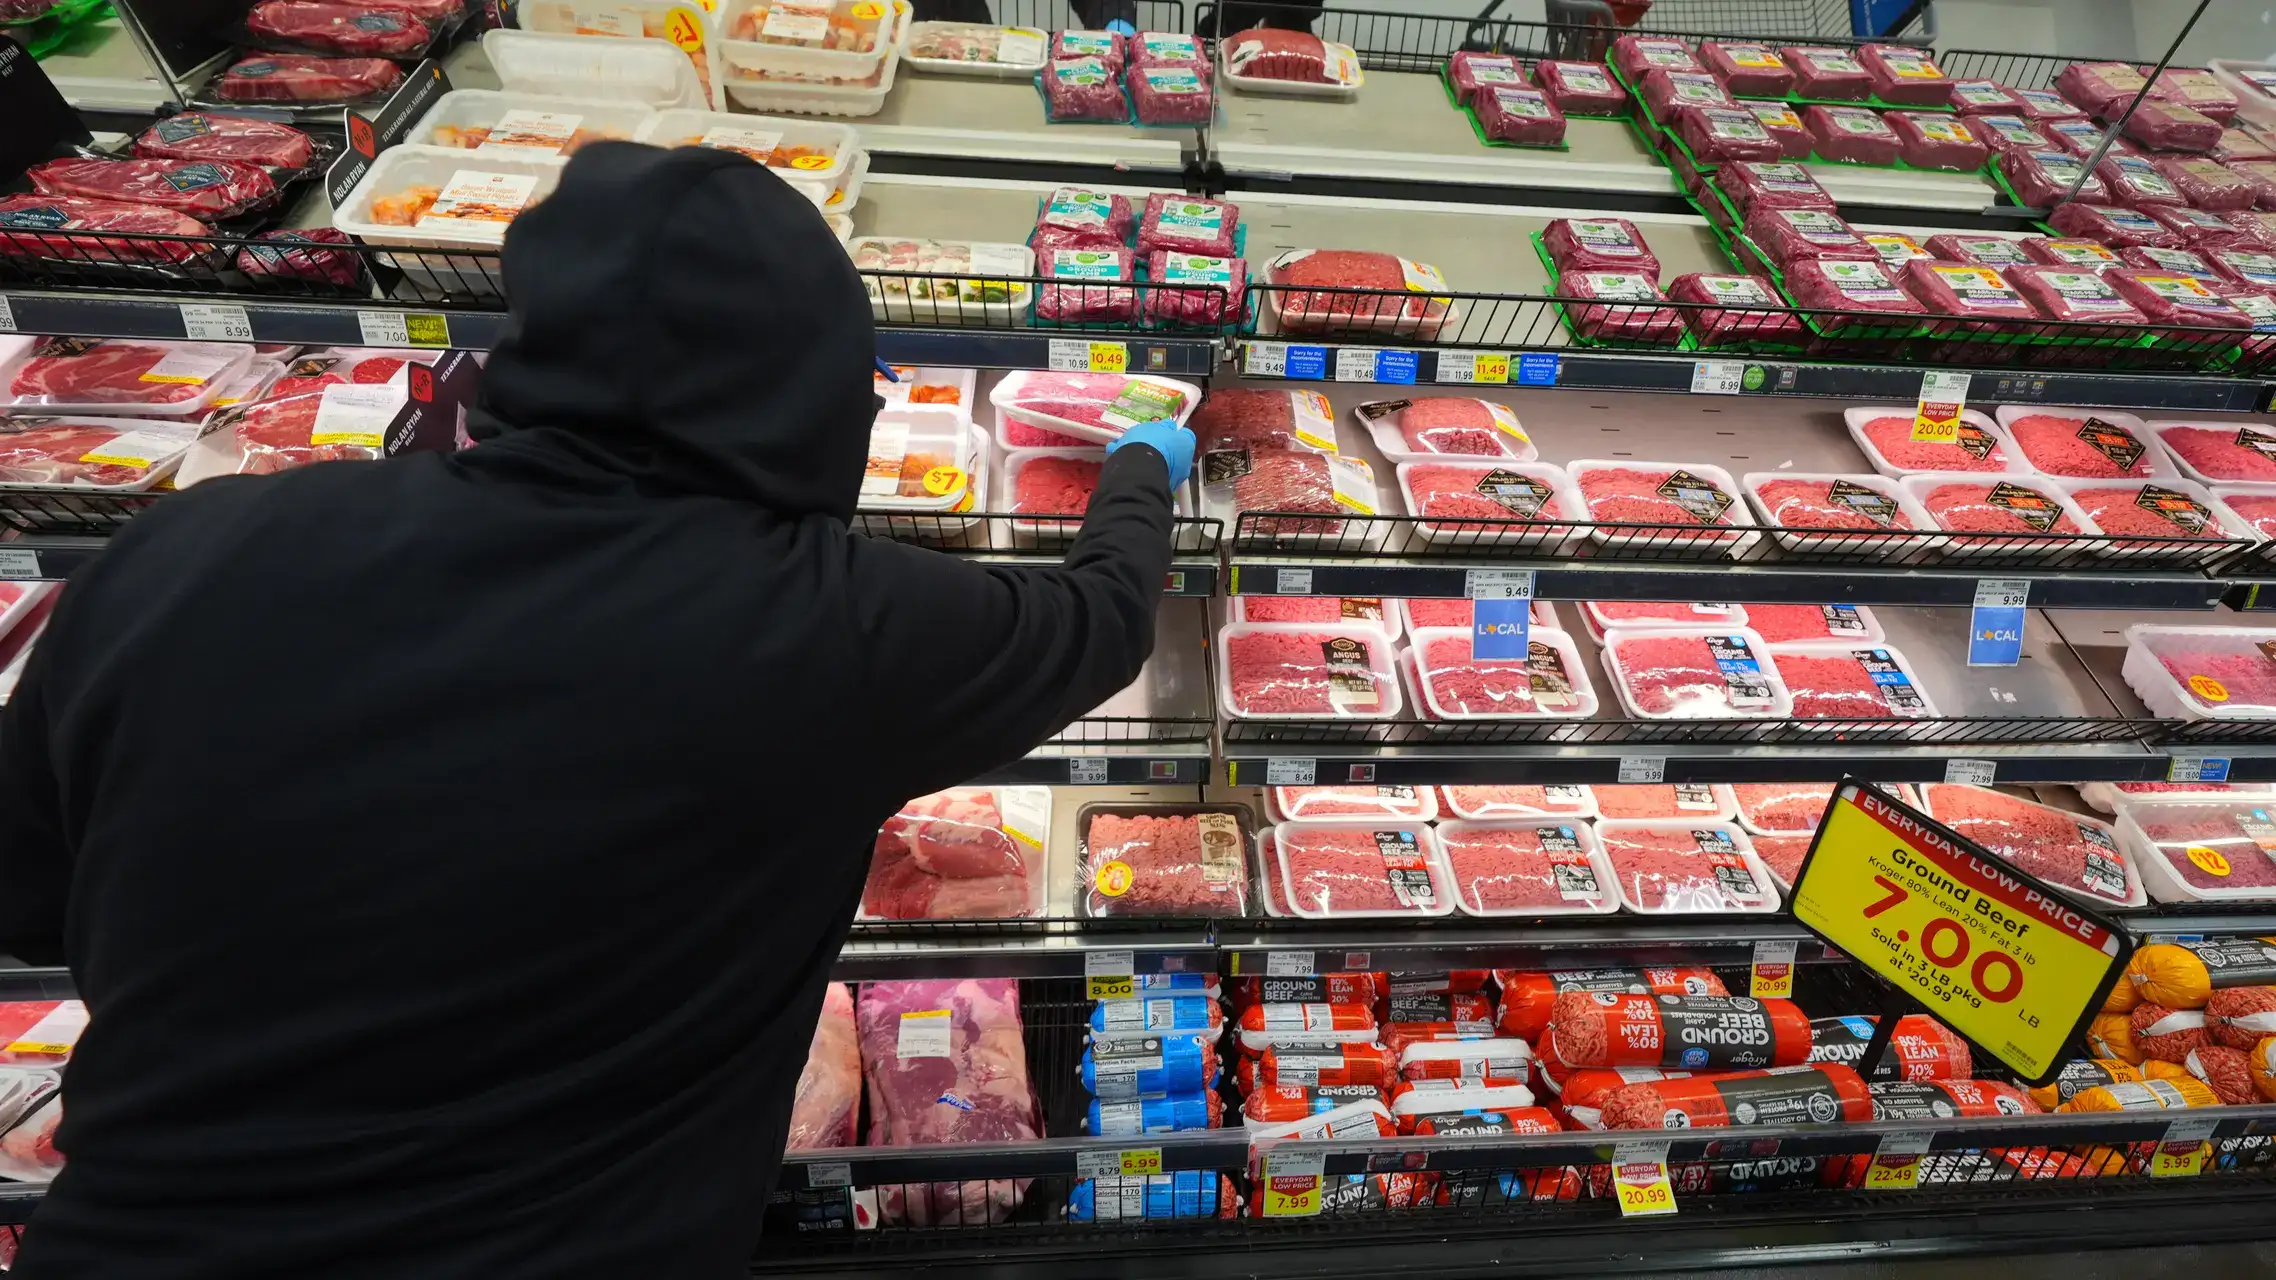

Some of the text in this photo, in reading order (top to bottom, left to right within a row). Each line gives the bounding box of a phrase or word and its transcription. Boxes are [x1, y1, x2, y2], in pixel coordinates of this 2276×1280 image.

[332, 160, 366, 202] NOLAN RYAN
[408, 319, 438, 331] NEW!
[226, 326, 250, 337] 8.99
[384, 331, 407, 342] 7.00
[1069, 359, 1089, 369] 10.99
[1091, 353, 1123, 364] 10.49
[1265, 363, 1285, 372] 9.49
[1476, 364, 1506, 375] 11.49
[1354, 369, 1373, 379] 10.49
[1455, 370, 1473, 380] 11.99
[1720, 380, 1739, 391] 8.99
[1926, 403, 1957, 411] EVERYDAY
[1939, 410, 1956, 418] PRICE
[388, 407, 423, 455] NOLAN RYAN
[1918, 423, 1953, 436] 20.00
[932, 470, 959, 491] $7
[1505, 587, 1530, 597] 9.49
[2003, 595, 2025, 606] 9.99
[1333, 651, 1361, 659] ANGUS
[2190, 678, 2224, 697] $15
[1088, 773, 1106, 781] 9.99
[1295, 773, 1314, 782] 8.49
[1645, 771, 1662, 780] 9.99
[1971, 775, 1991, 784] 27.99
[2185, 772, 2200, 780] 15.00
[2191, 851, 2226, 870] $12
[1863, 794, 2097, 940] EVERYDAY LOW PRICE
[1892, 848, 2031, 939] Ground Beef
[1868, 855, 2036, 967] Kroger 80% Lean 20% Fat 3 lb
[1863, 874, 2024, 1004] 7.00
[1295, 966, 1312, 974] 7.99
[1871, 926, 1983, 1009] Sold in 3 LB pkg
[1556, 971, 1595, 982] BEEF
[1654, 976, 1675, 986] FAT
[1889, 954, 1952, 1004] at $20.99
[1092, 984, 1131, 995] 8.00
[1264, 980, 1317, 991] GROUND
[1331, 985, 1353, 993] LEAN
[1687, 978, 1706, 994] 3lb
[1756, 981, 1787, 991] 20.99
[1265, 991, 1293, 1001] BEEF
[1332, 995, 1349, 1003] 20%
[1392, 1000, 1418, 1009] BEEF
[1627, 999, 1653, 1009] FAT
[1456, 1013, 1471, 1021] FAT
[1624, 1007, 1656, 1020] 20%
[2018, 1008, 2040, 1029] LB
[1718, 1013, 1766, 1029] BEEF
[1620, 1024, 1659, 1037] LEAN
[1681, 1028, 1770, 1045] GROUND
[1897, 1035, 1928, 1046] 80%
[1628, 1036, 1659, 1049] 80%
[1730, 1050, 1768, 1067] Kroger
[1903, 1046, 1939, 1060] LEAN
[1908, 1064, 1935, 1076] 20%
[1318, 1087, 1378, 1096] GROUND
[1787, 1098, 1805, 1111] 19g
[1957, 1093, 1985, 1105] FAT
[2000, 1098, 2021, 1115] 5lb
[1890, 1108, 1905, 1120] 19g
[1434, 1117, 1461, 1126] Kroger
[1517, 1118, 1540, 1127] 80%
[1763, 1115, 1807, 1125] NO ADDITIVES
[1440, 1125, 1503, 1135] GROUND
[1123, 1158, 1158, 1168] 6.99
[2163, 1157, 2191, 1169] 5.99
[1098, 1167, 1120, 1175] 8.79
[1621, 1165, 1658, 1173] EVERYDAY
[1874, 1170, 1912, 1181] 22.49
[1625, 1189, 1667, 1204] 20.99
[1277, 1196, 1309, 1209] 7.99
